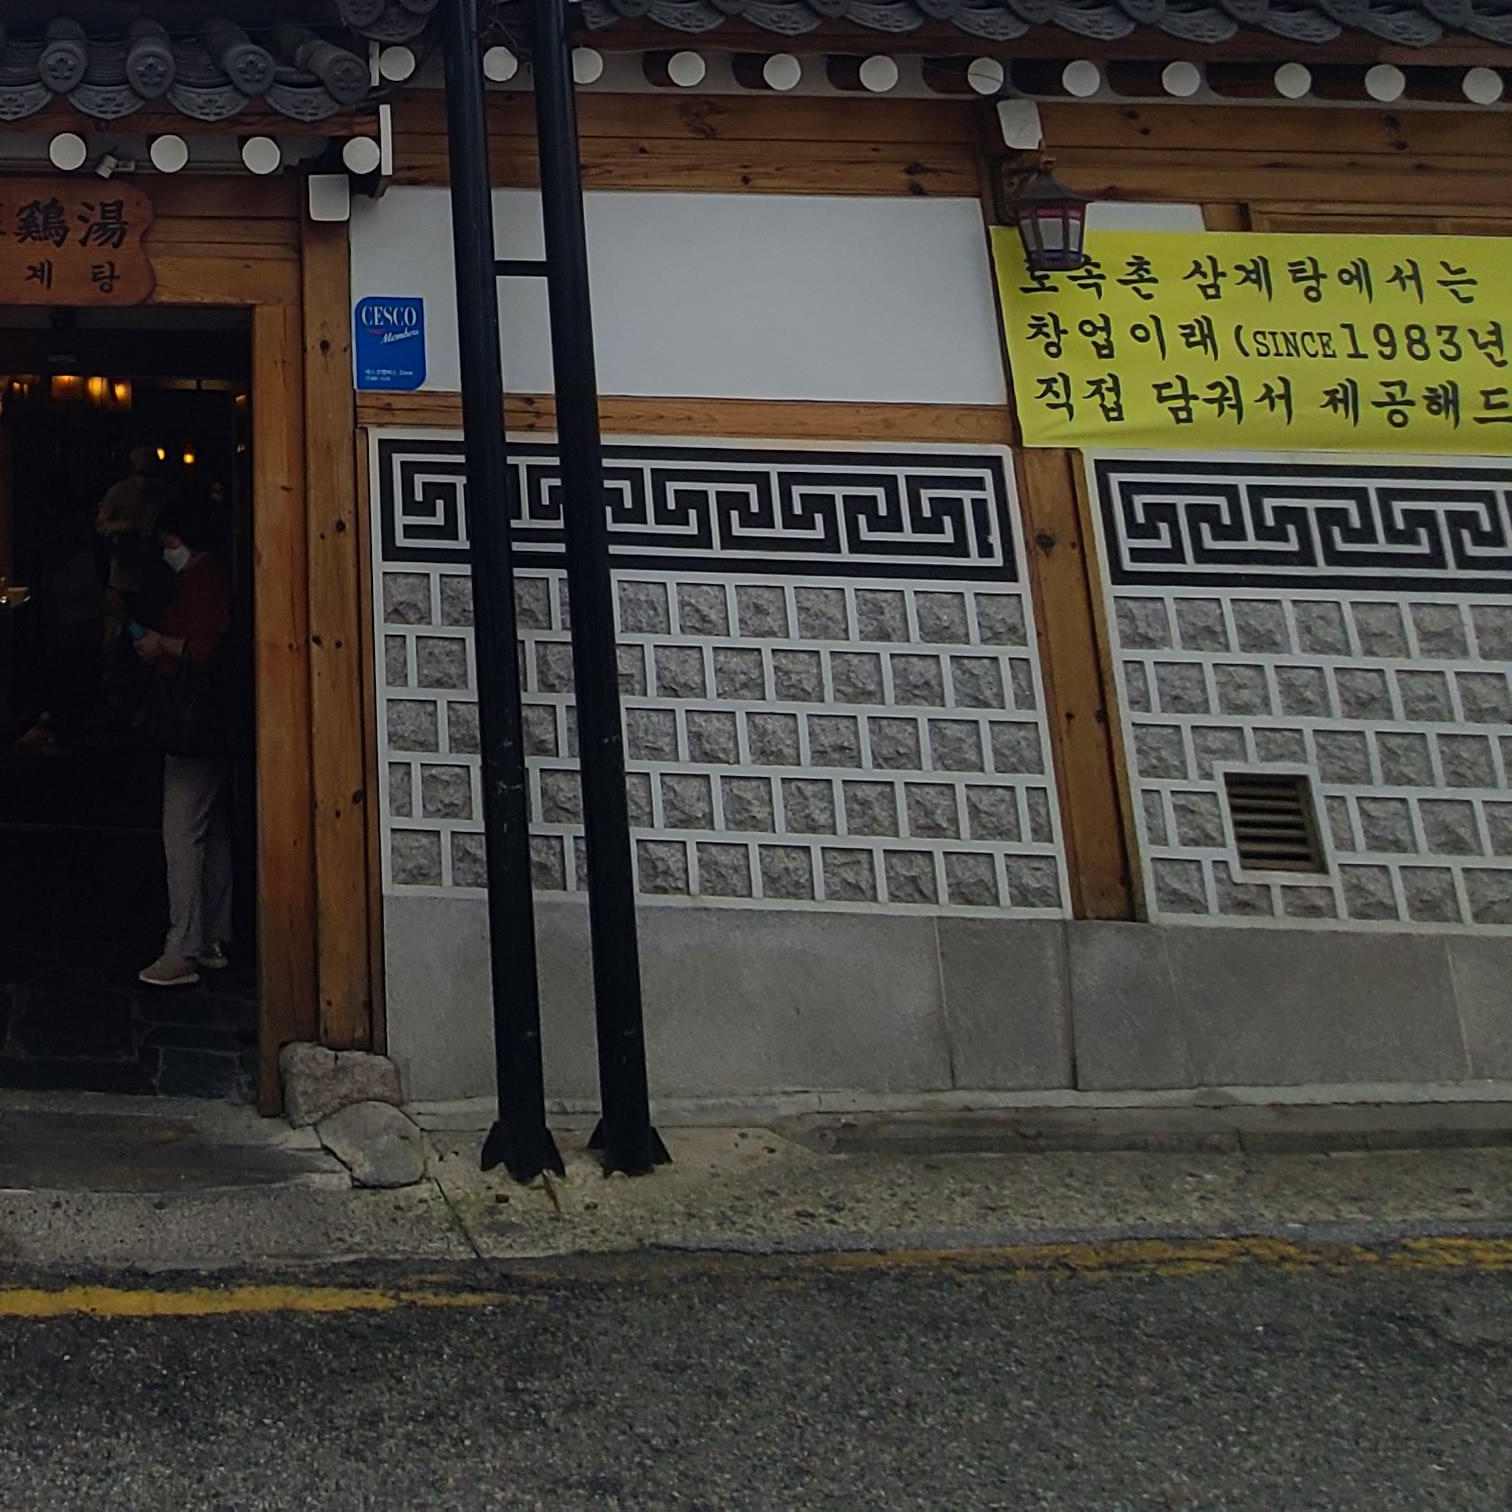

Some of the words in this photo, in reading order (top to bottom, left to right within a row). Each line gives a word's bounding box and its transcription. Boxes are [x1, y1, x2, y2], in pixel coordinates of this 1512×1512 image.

[1182, 255, 1479, 305] 삼계탕에서는
[362, 306, 417, 326] CESCO
[1035, 372, 1123, 423] 직접
[1152, 374, 1294, 426] 담궈서
